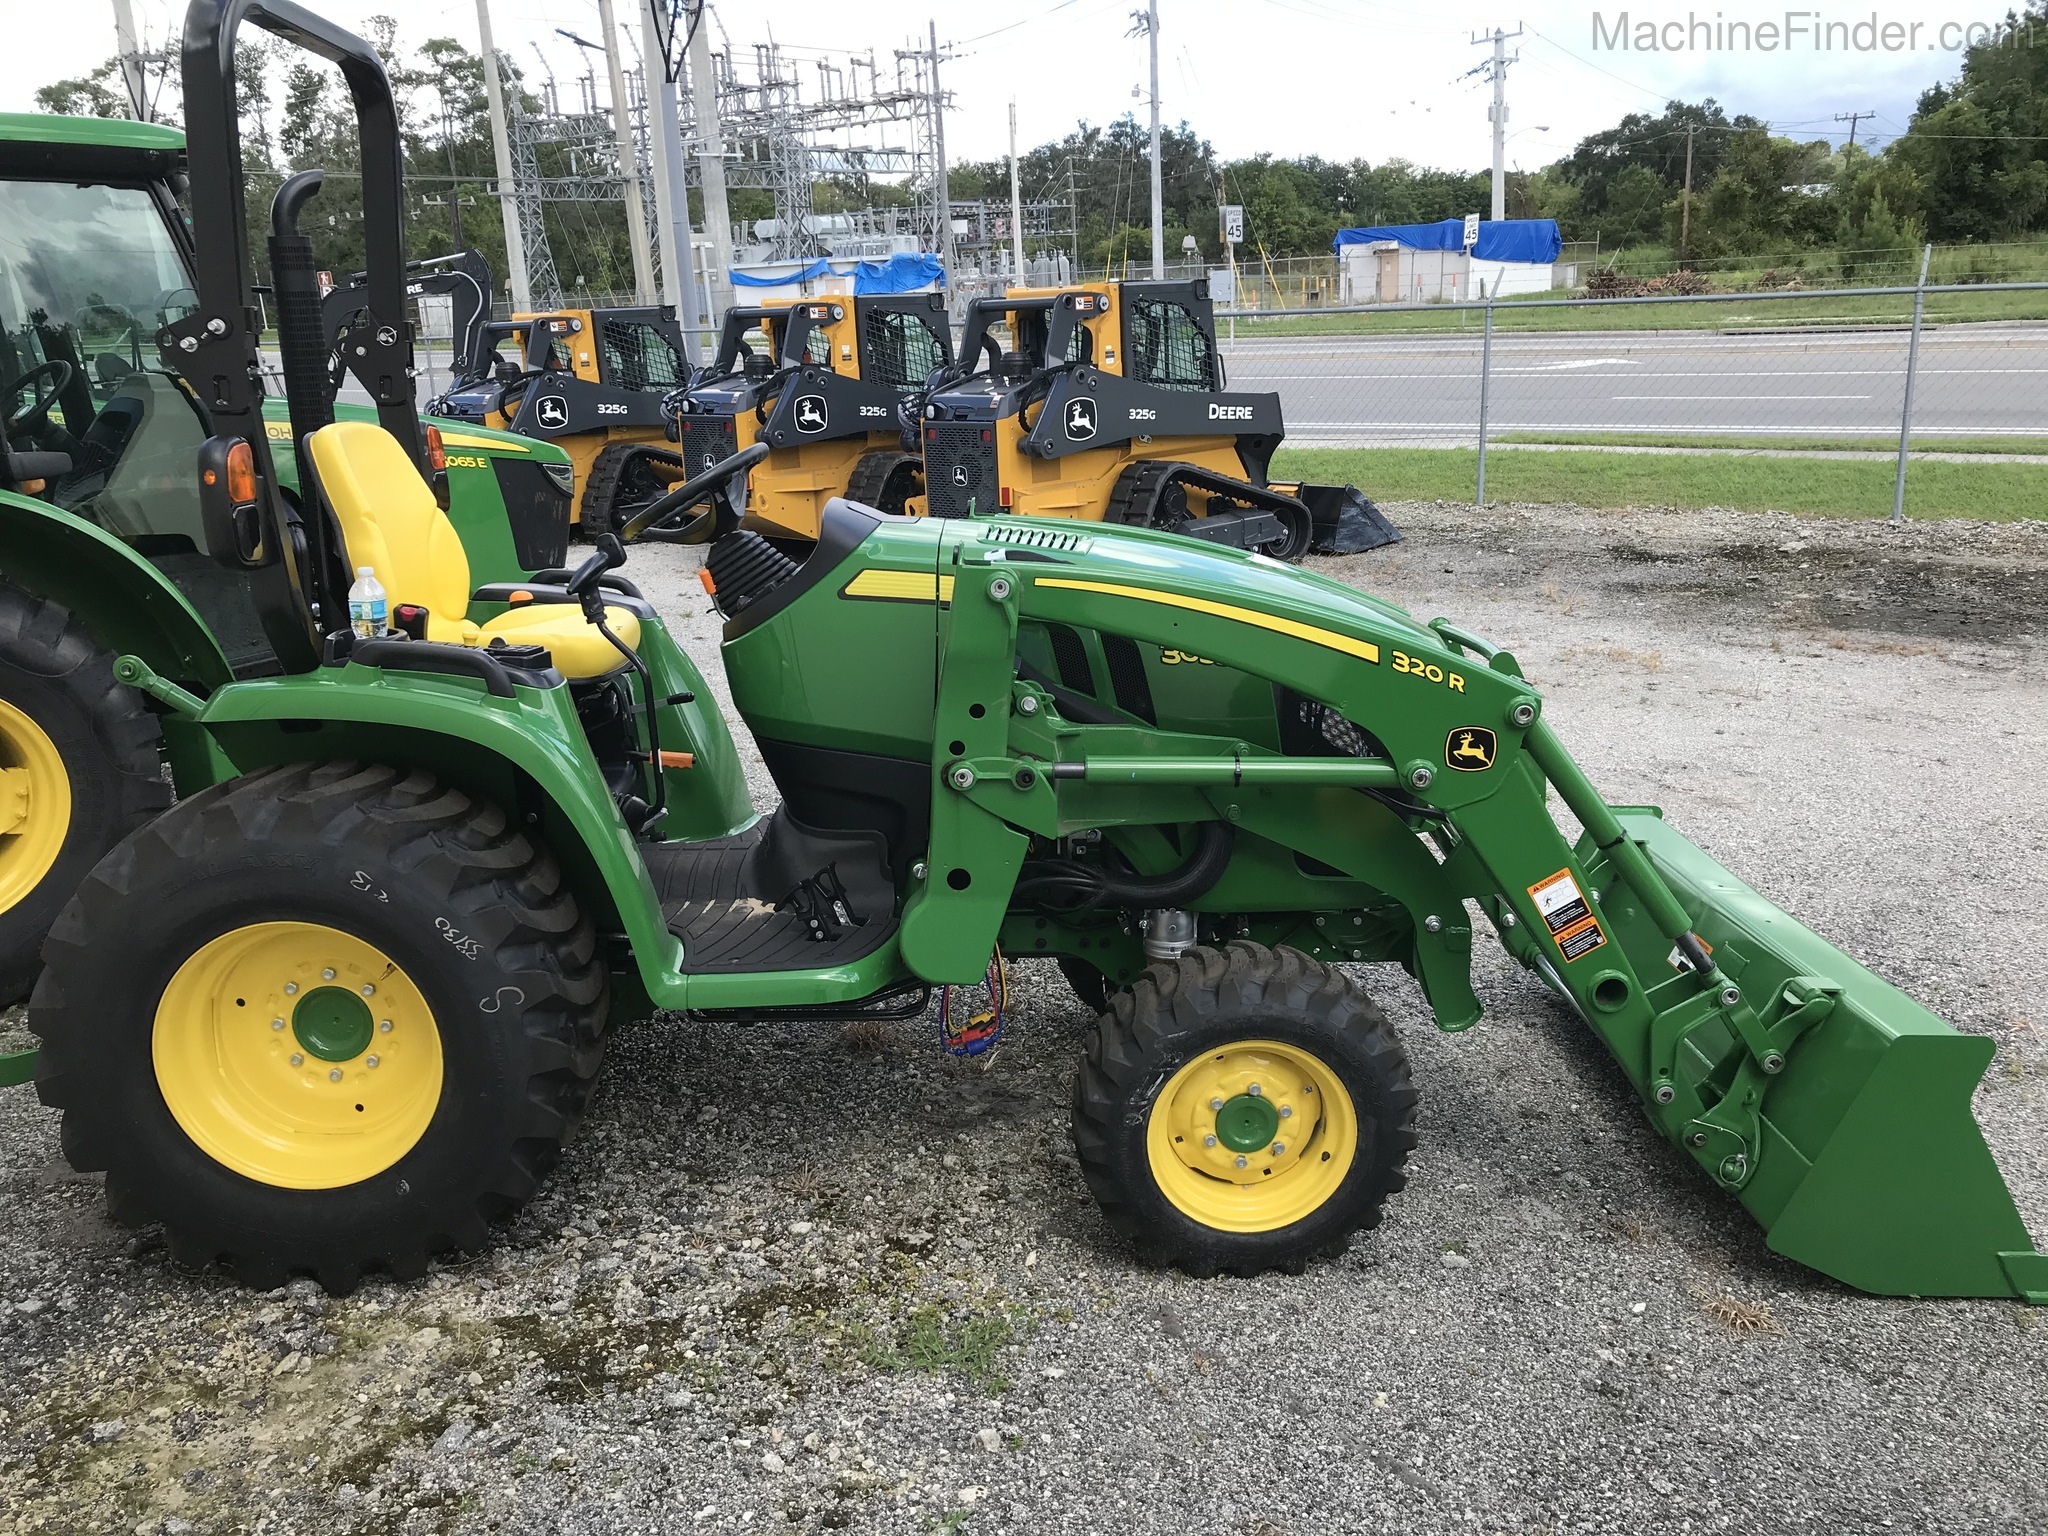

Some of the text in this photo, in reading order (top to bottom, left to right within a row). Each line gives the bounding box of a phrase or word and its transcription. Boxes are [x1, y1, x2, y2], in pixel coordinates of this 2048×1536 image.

[1227, 225, 1241, 238] 45
[1465, 229, 1477, 240] 45
[597, 404, 628, 414] 325G
[859, 406, 887, 416] 325G
[1128, 409, 1156, 420] 325G
[1208, 403, 1253, 420] DEERE
[267, 427, 292, 437] OH
[477, 457, 488, 468] E
[1392, 650, 1466, 693] 320 R
[1539, 872, 1565, 889] WARNING
[1566, 921, 1592, 937] WARNING
